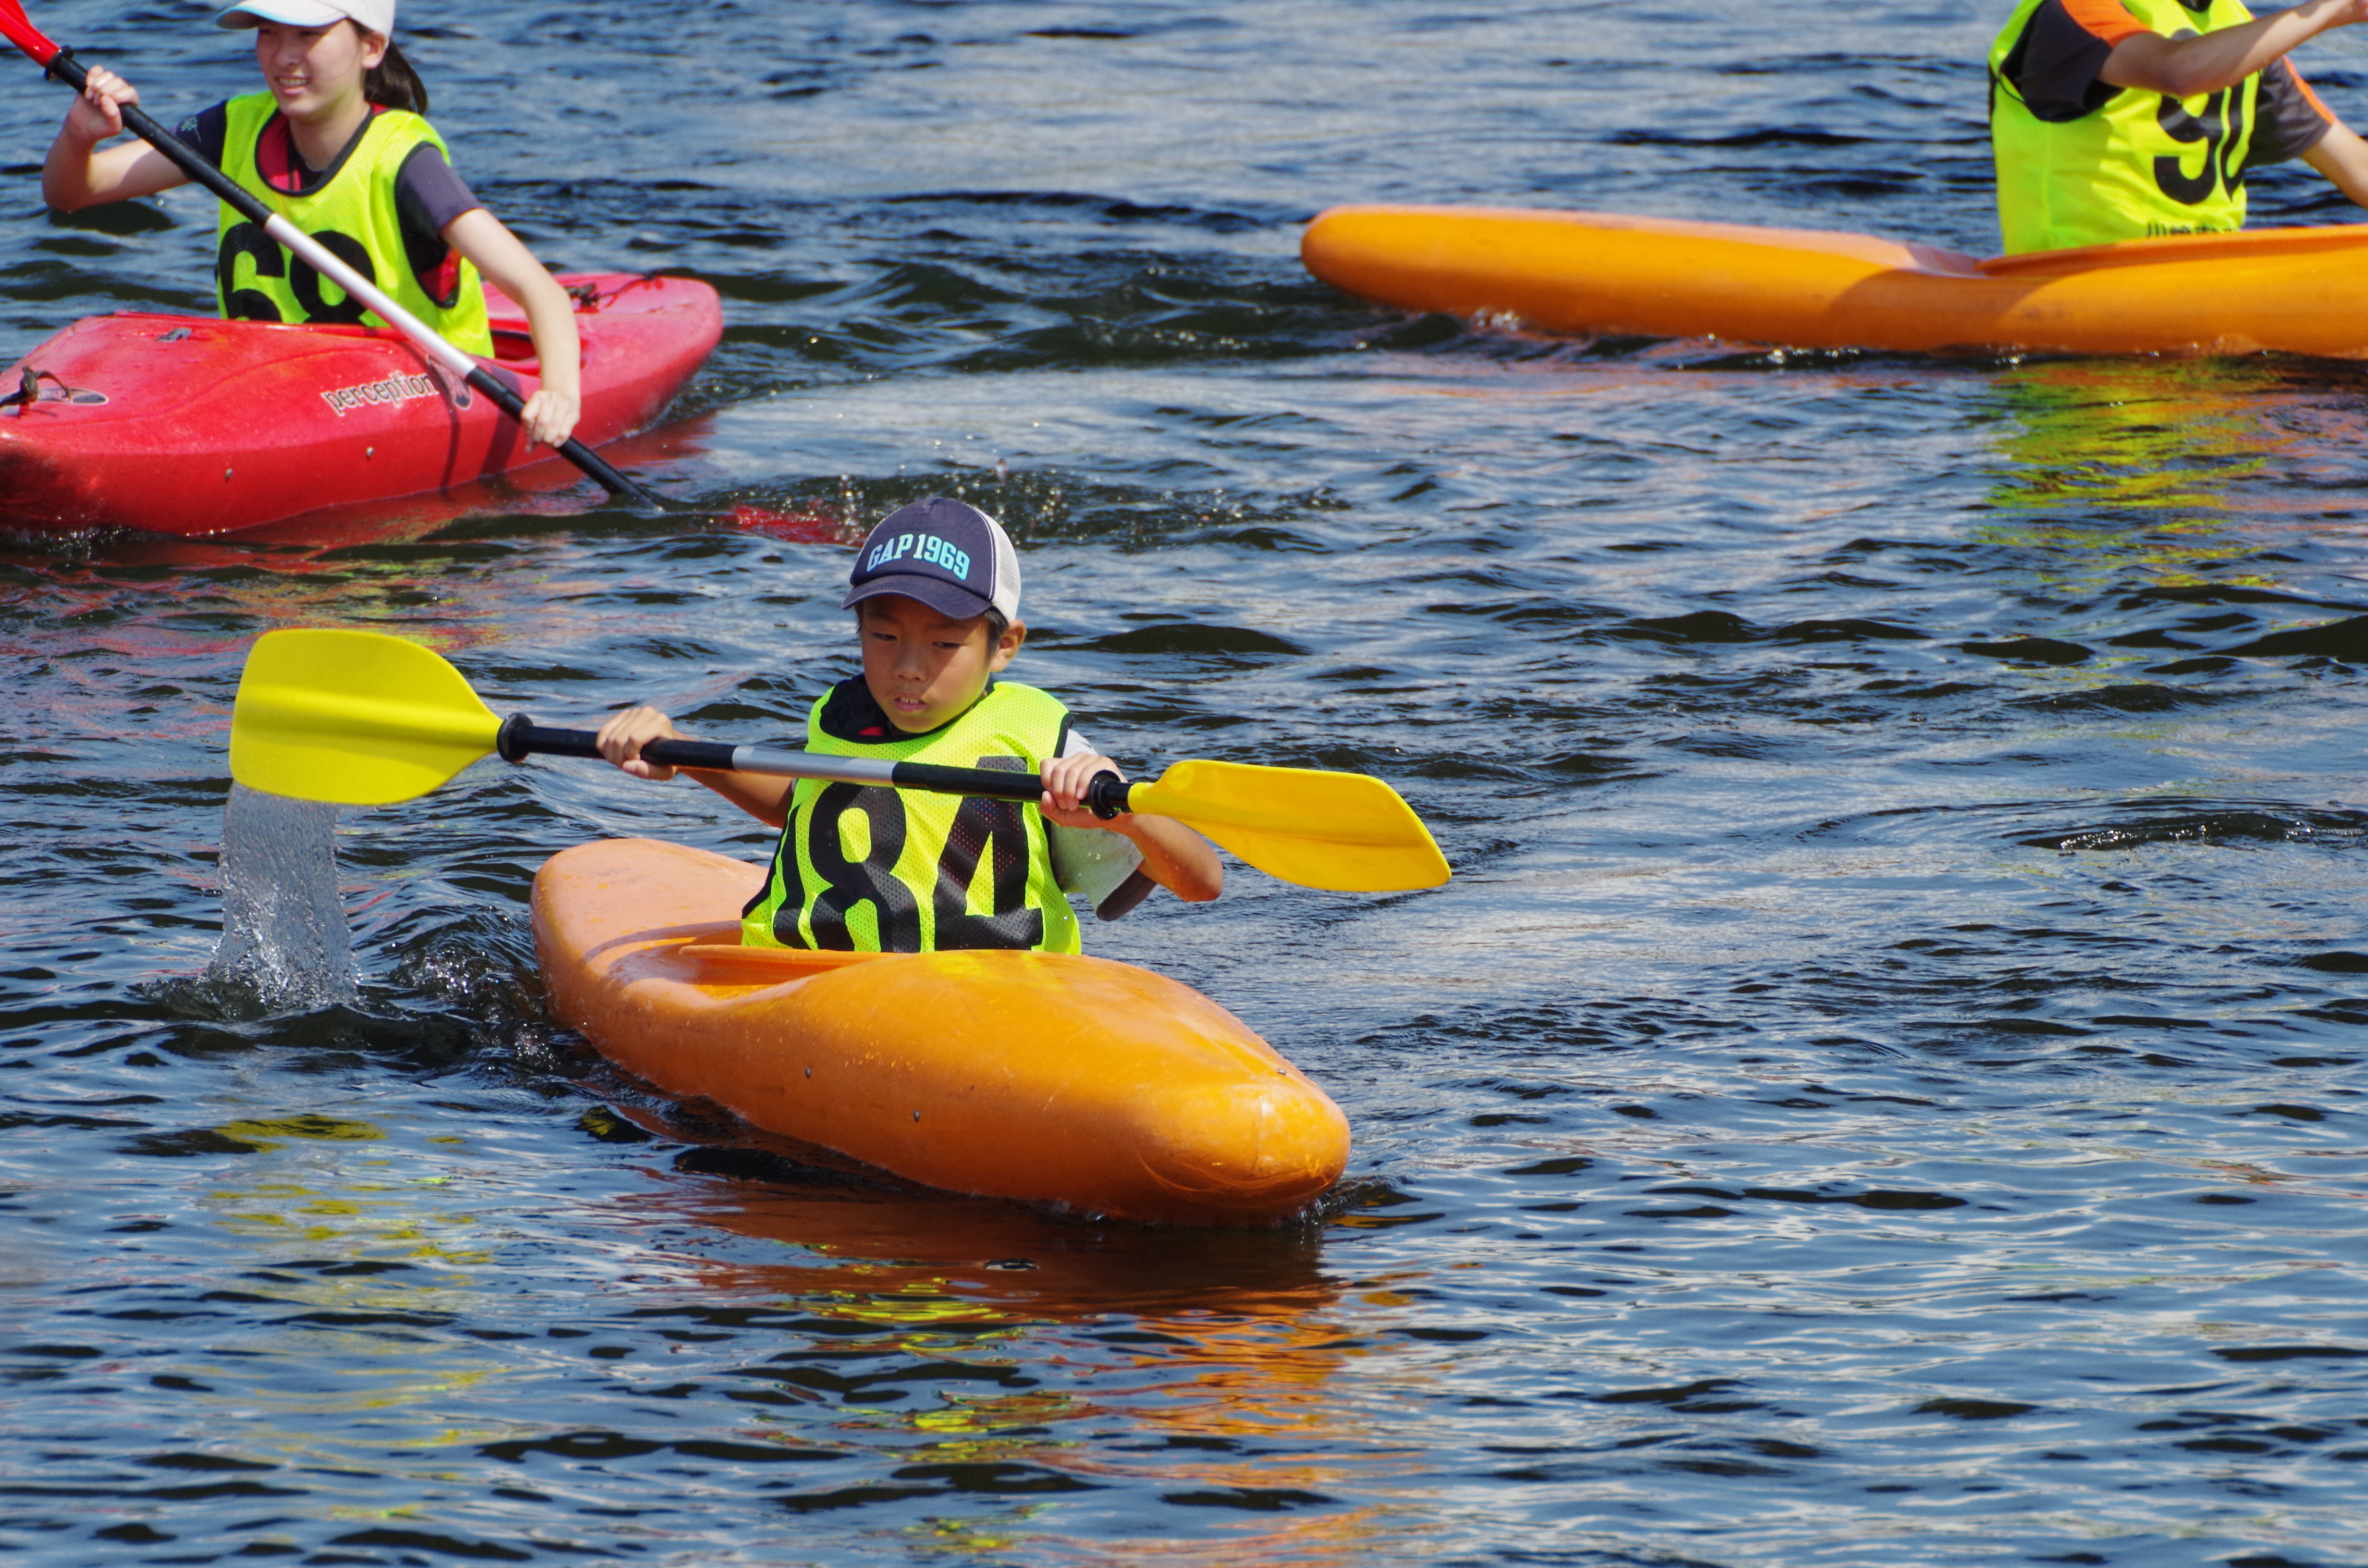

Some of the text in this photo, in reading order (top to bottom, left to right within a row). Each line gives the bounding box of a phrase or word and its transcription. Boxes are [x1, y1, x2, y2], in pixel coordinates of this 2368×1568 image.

[320, 370, 440, 417] perception
[866, 533, 970, 581] GAP 1969
